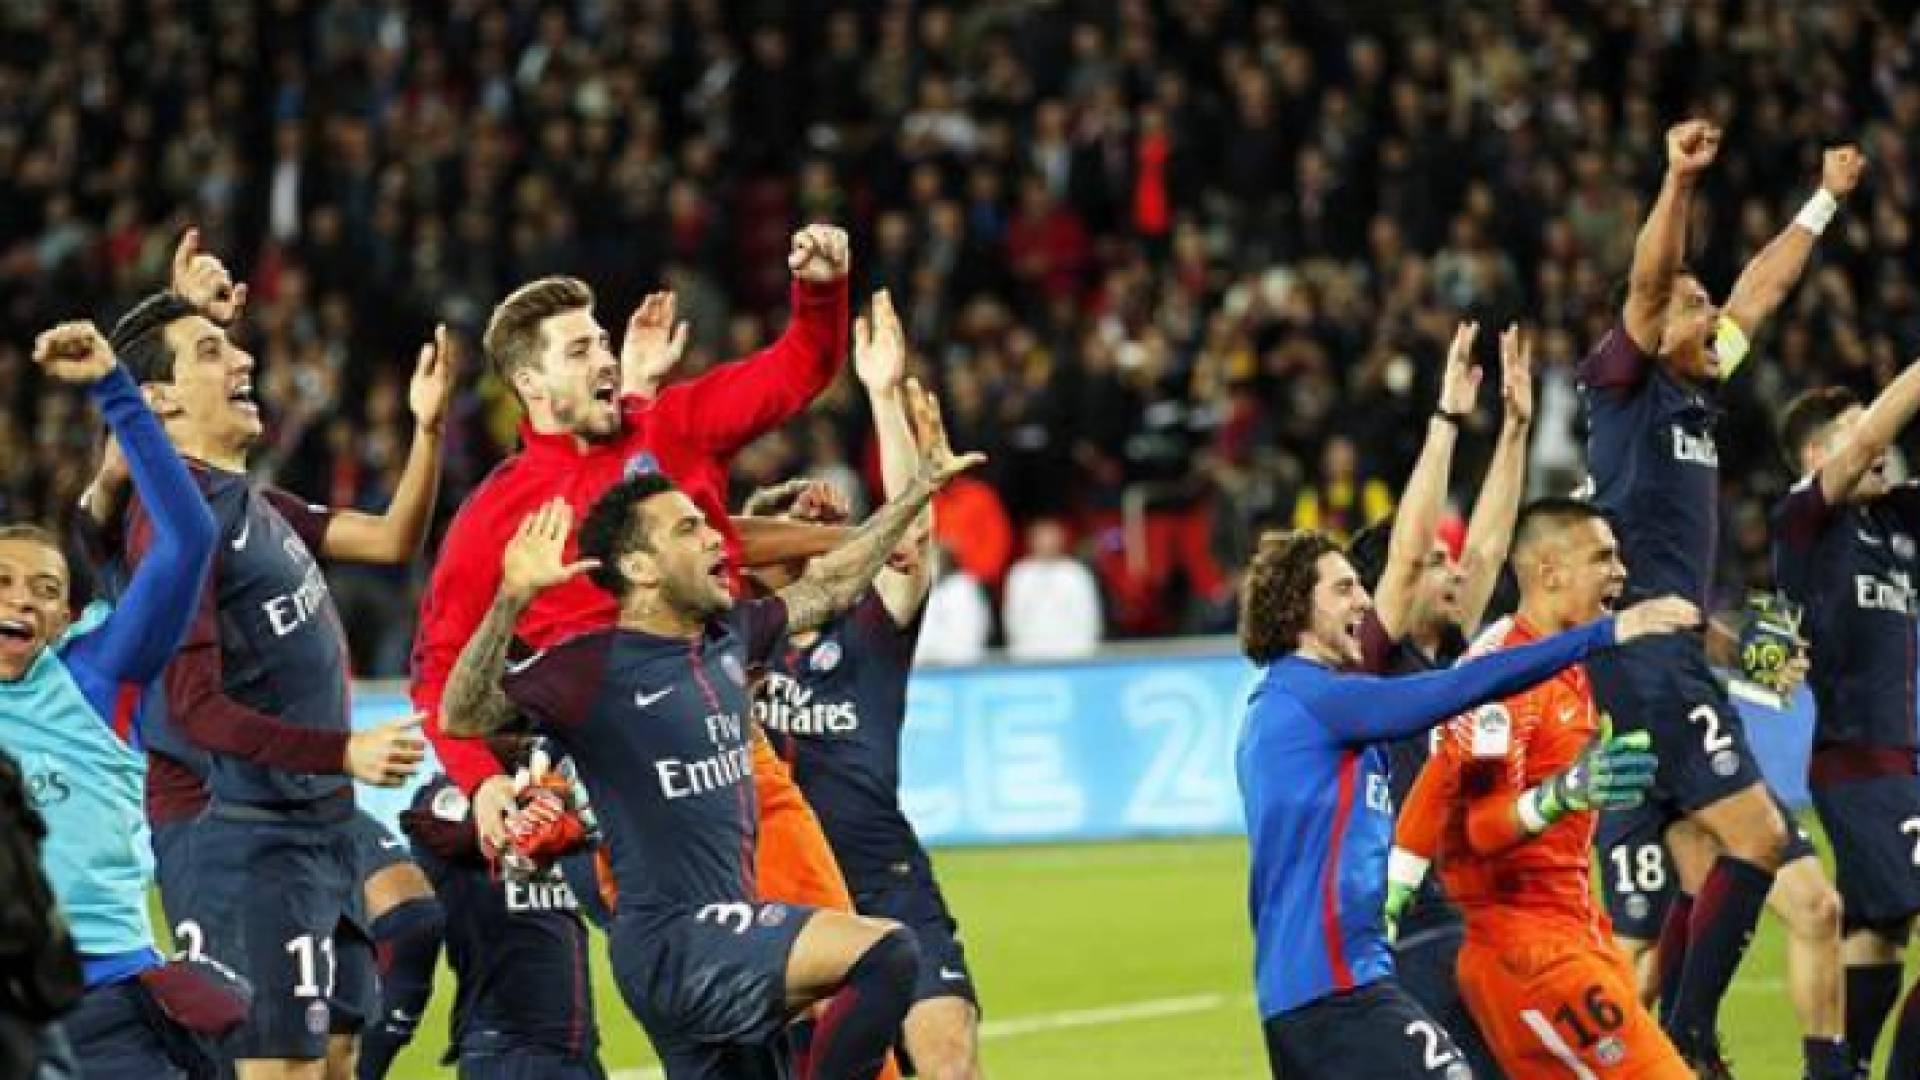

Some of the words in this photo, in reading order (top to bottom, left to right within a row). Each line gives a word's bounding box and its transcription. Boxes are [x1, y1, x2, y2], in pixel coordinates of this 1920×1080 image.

[1687, 704, 1733, 753] 2
[1611, 844, 1666, 892] 18
[695, 901, 753, 934] 3
[285, 934, 336, 1000] 11
[1553, 984, 1624, 1049] 16
